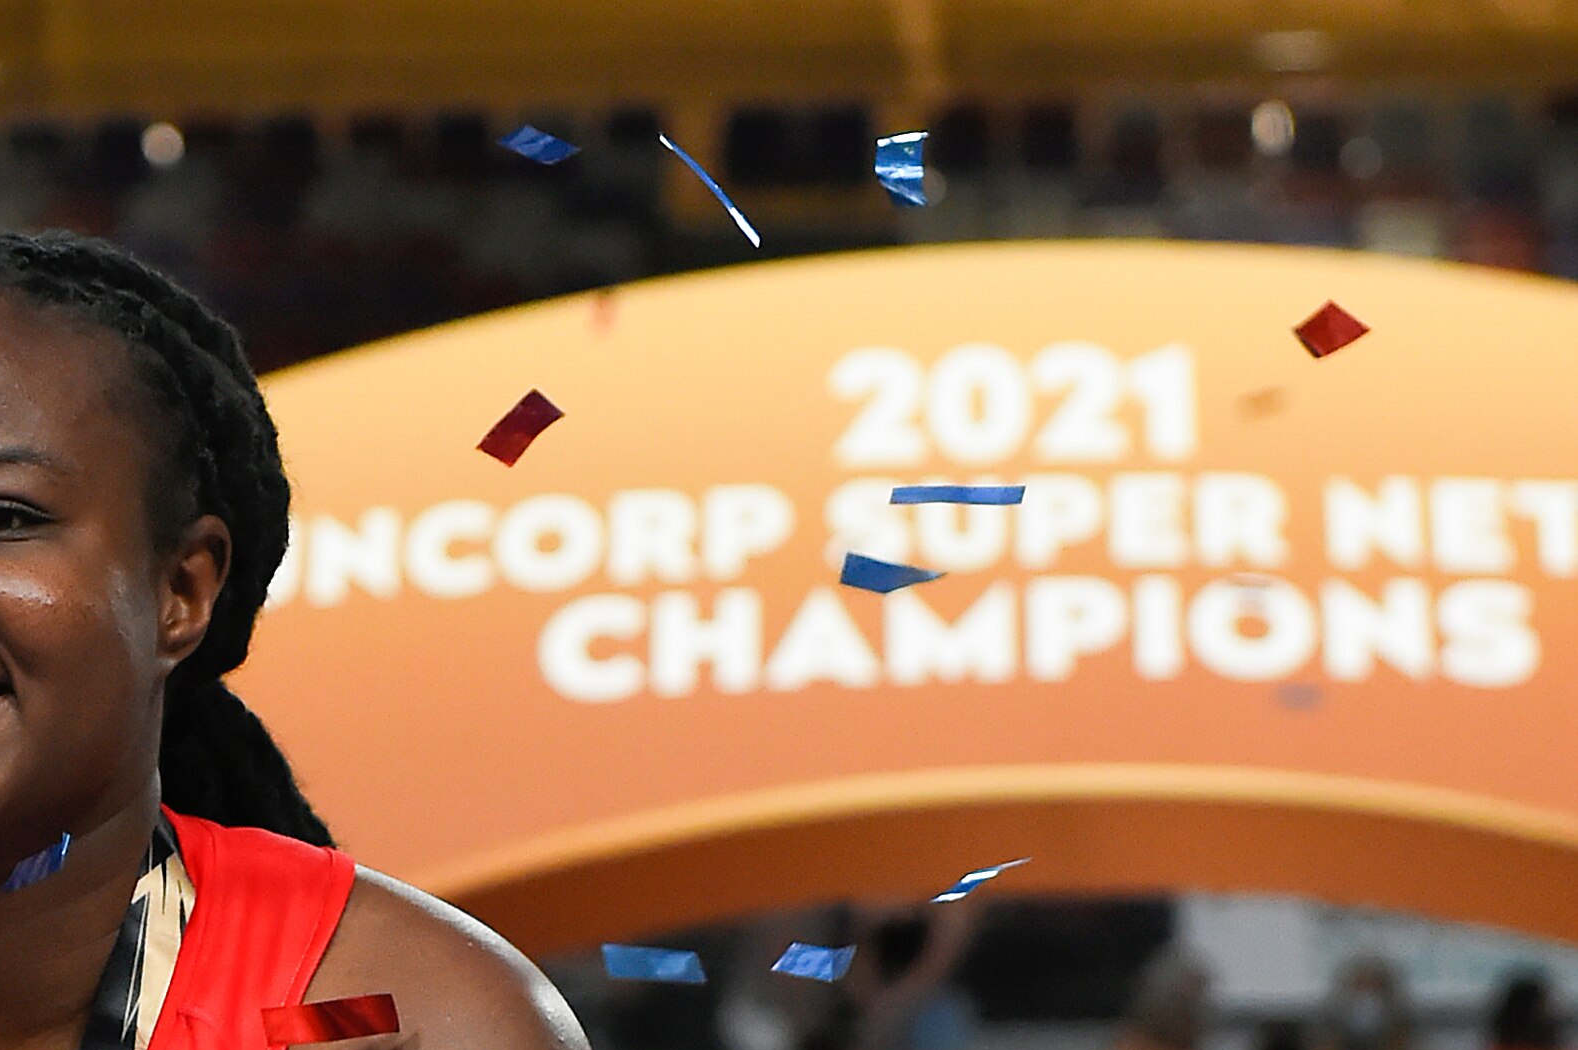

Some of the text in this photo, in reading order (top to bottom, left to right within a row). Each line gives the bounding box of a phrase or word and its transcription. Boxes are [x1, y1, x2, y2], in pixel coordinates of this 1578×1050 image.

[828, 341, 1197, 467] 2021
[265, 483, 796, 609] NCORP
[826, 471, 1290, 573] SUPER
[537, 574, 1540, 702] CHAMPIONS
